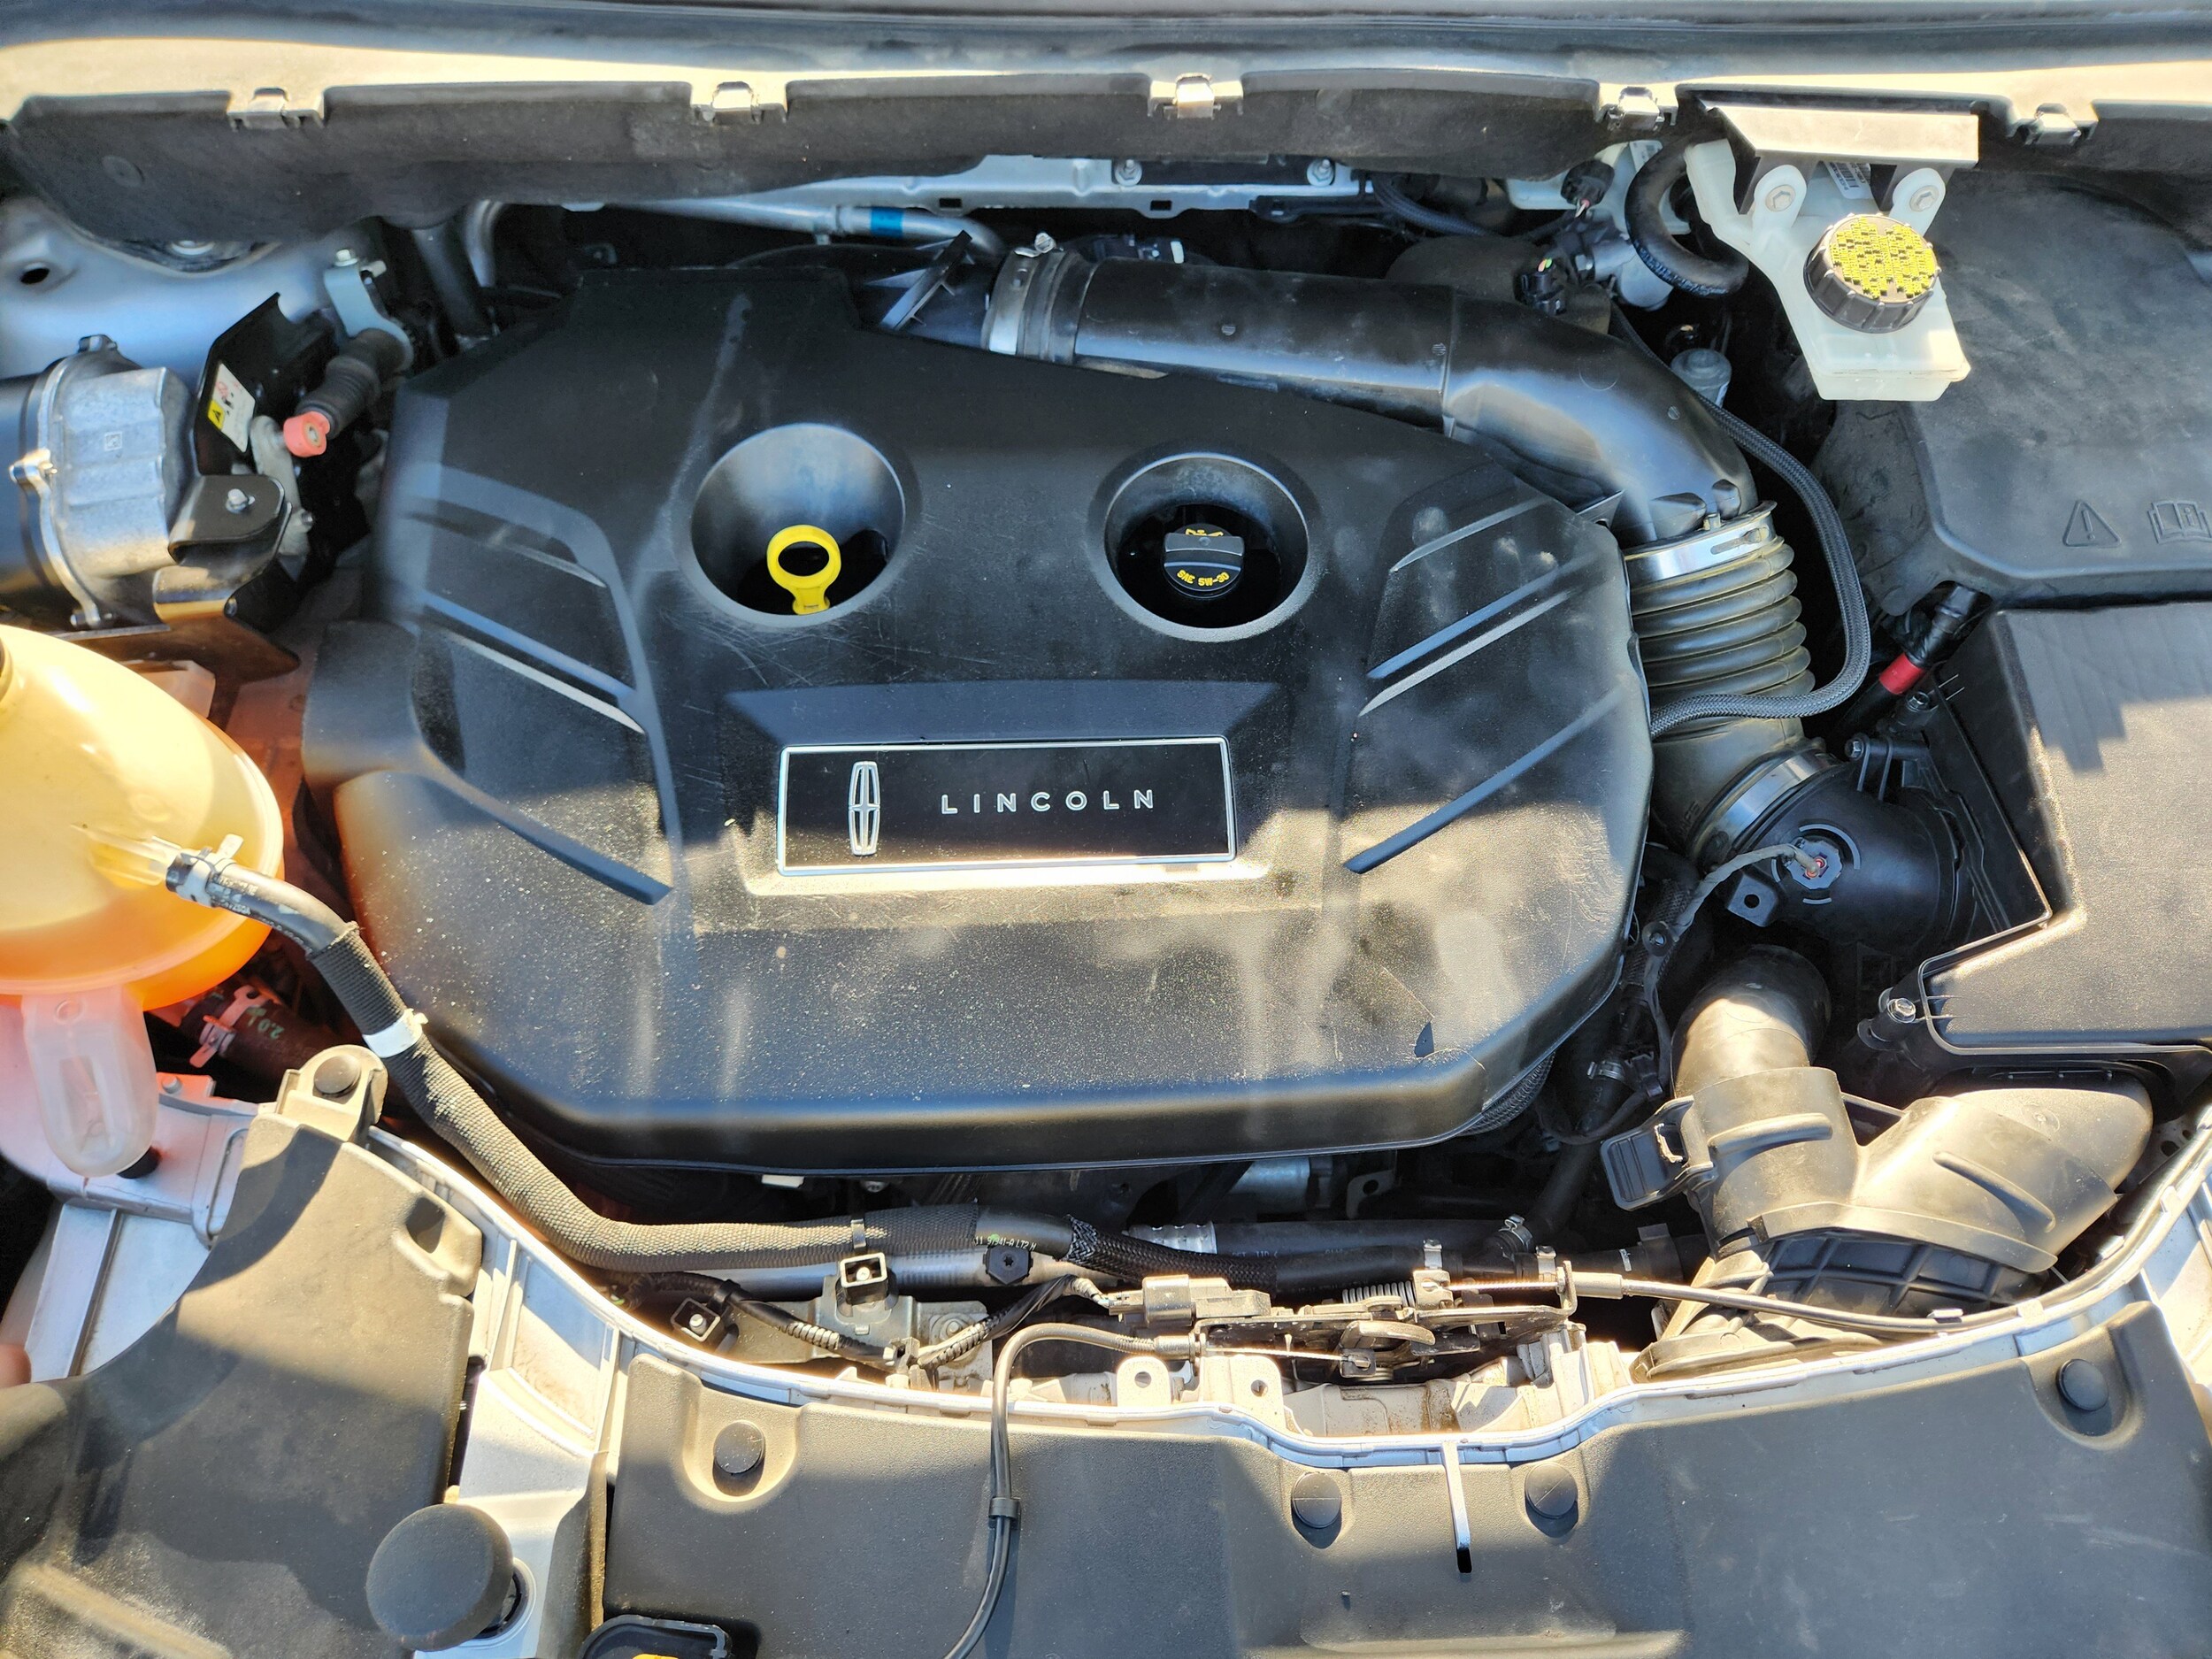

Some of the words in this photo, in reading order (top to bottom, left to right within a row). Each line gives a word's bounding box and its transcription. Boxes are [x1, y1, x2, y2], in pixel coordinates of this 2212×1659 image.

[1177, 569, 1195, 584] SAE
[1197, 572, 1230, 587] 5W-30
[941, 788, 1155, 815] LINCOLN
